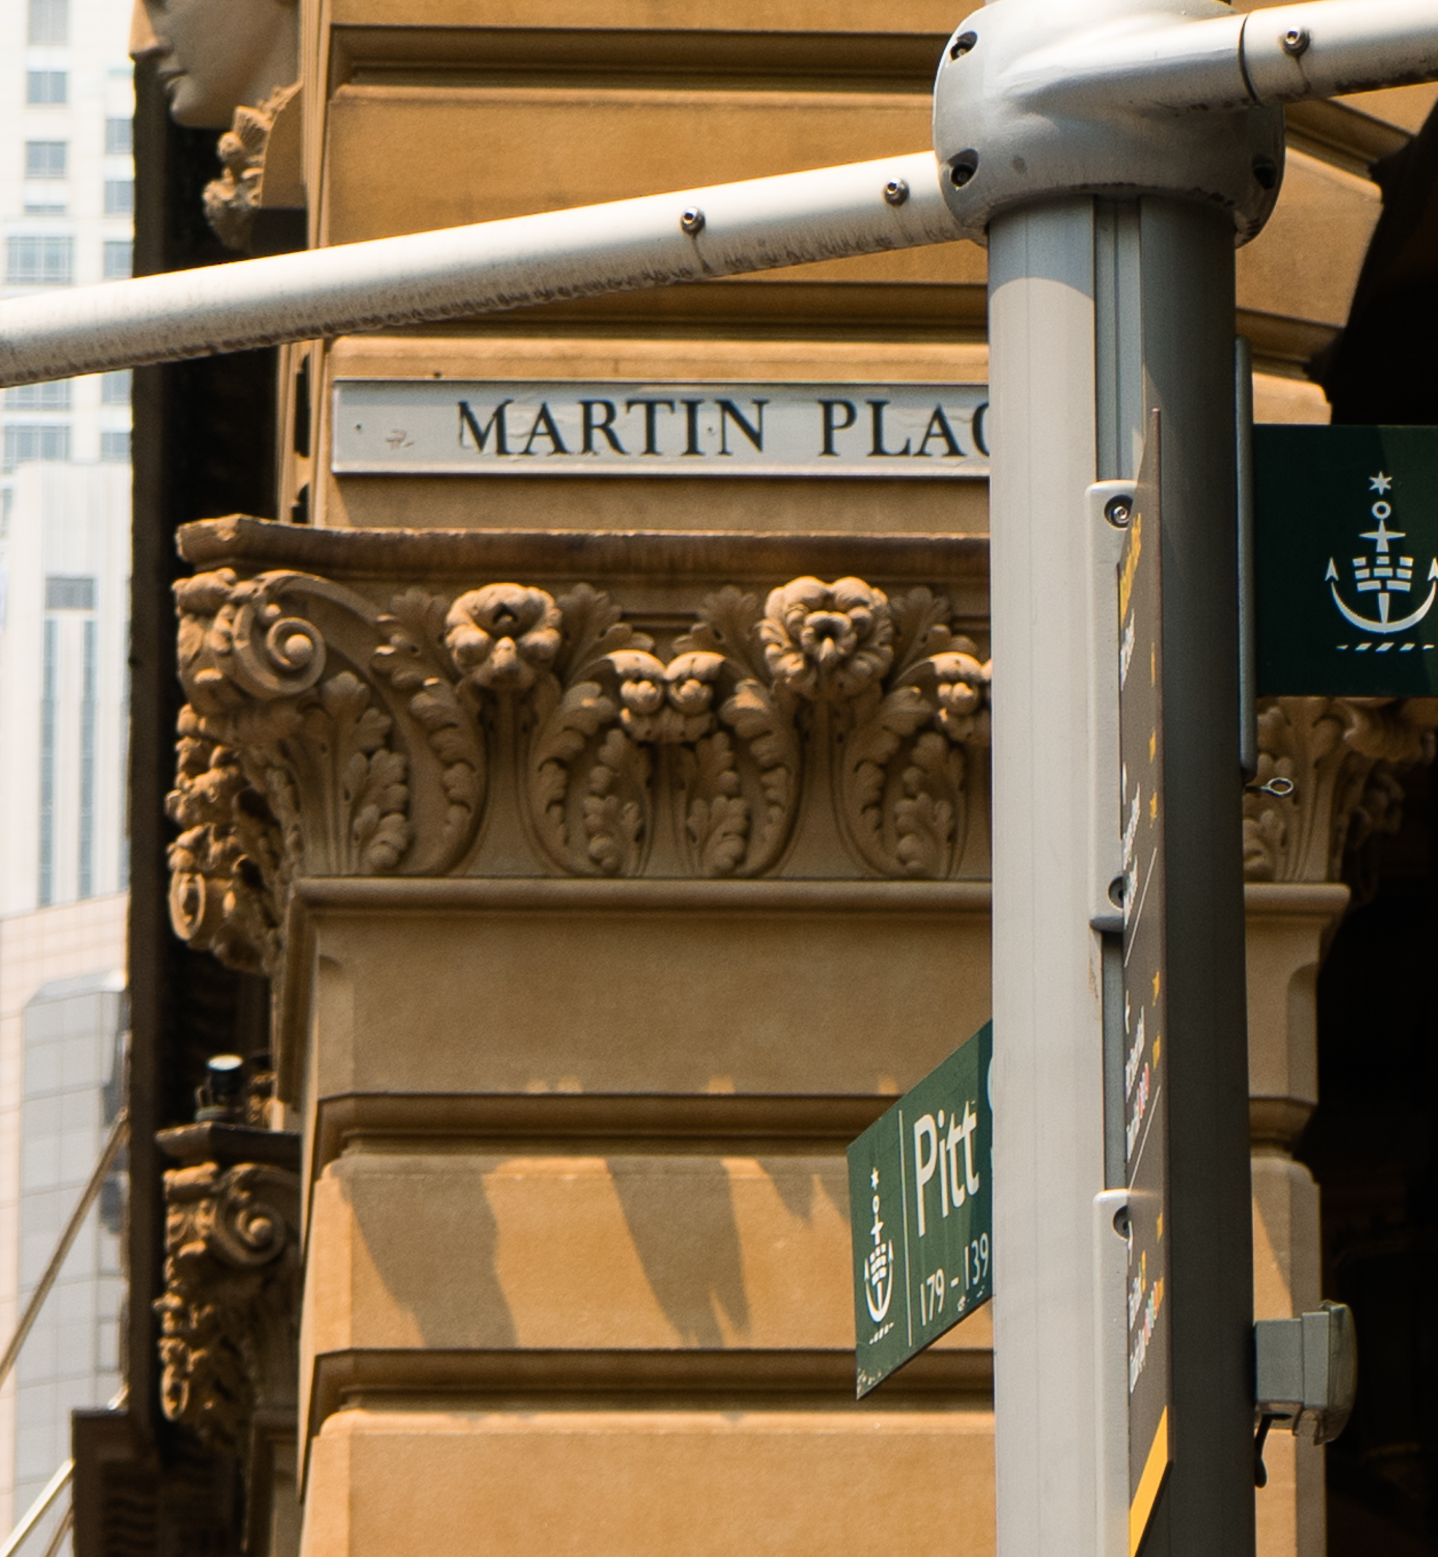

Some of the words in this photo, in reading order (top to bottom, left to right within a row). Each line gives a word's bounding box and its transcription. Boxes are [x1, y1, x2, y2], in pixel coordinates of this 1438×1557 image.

[457, 396, 772, 457] MARTIN
[912, 1099, 980, 1239] Pitt
[920, 1268, 946, 1327] 179
[964, 1232, 989, 1291] 139
